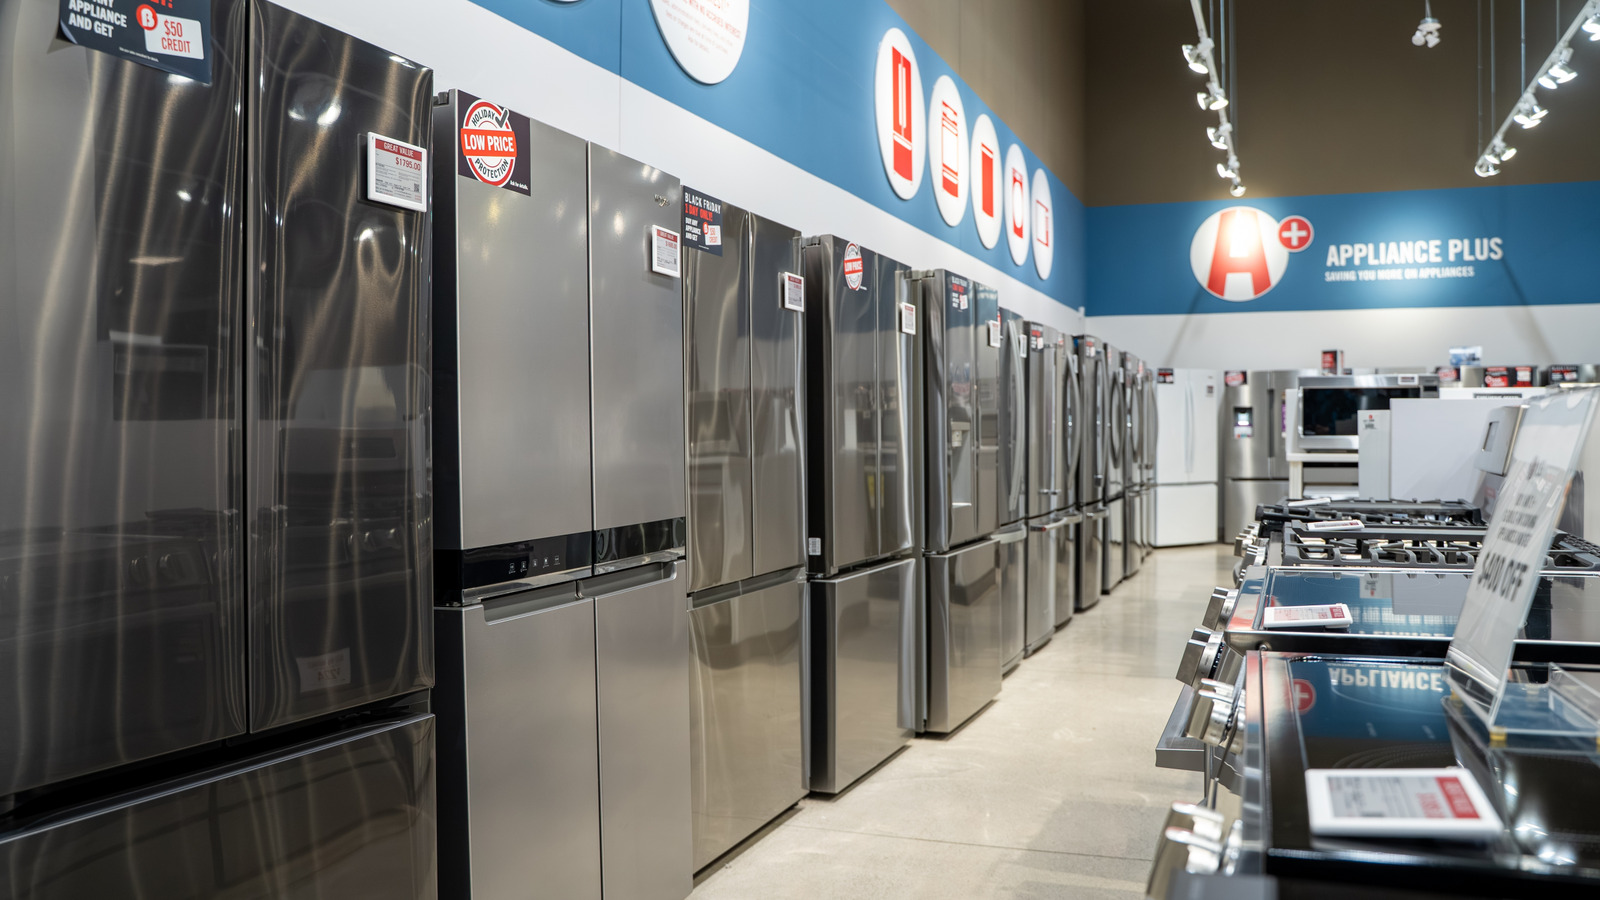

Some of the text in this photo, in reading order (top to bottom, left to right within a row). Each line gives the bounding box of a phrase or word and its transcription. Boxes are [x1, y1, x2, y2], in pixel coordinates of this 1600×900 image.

[69, 0, 127, 28] APPLIANCE
[68, 12, 114, 38] AND GET
[164, 18, 183, 38] $50
[161, 37, 191, 53] CREDIT
[471, 109, 496, 127] HOLIDAY
[383, 142, 414, 158] GREAT VALUE
[464, 134, 515, 152] LOW PRICE
[395, 157, 421, 171] $1795.00
[475, 158, 509, 179] PROTECTION
[685, 192, 702, 207] BLACK
[703, 199, 721, 215] FRIDAY
[685, 203, 688, 214] 1
[689, 204, 699, 217] DAY
[1326, 237, 1504, 268] APPLIANCE PLUS
[1324, 266, 1475, 282] SAVING YOU MORE ON APPLIANCES
